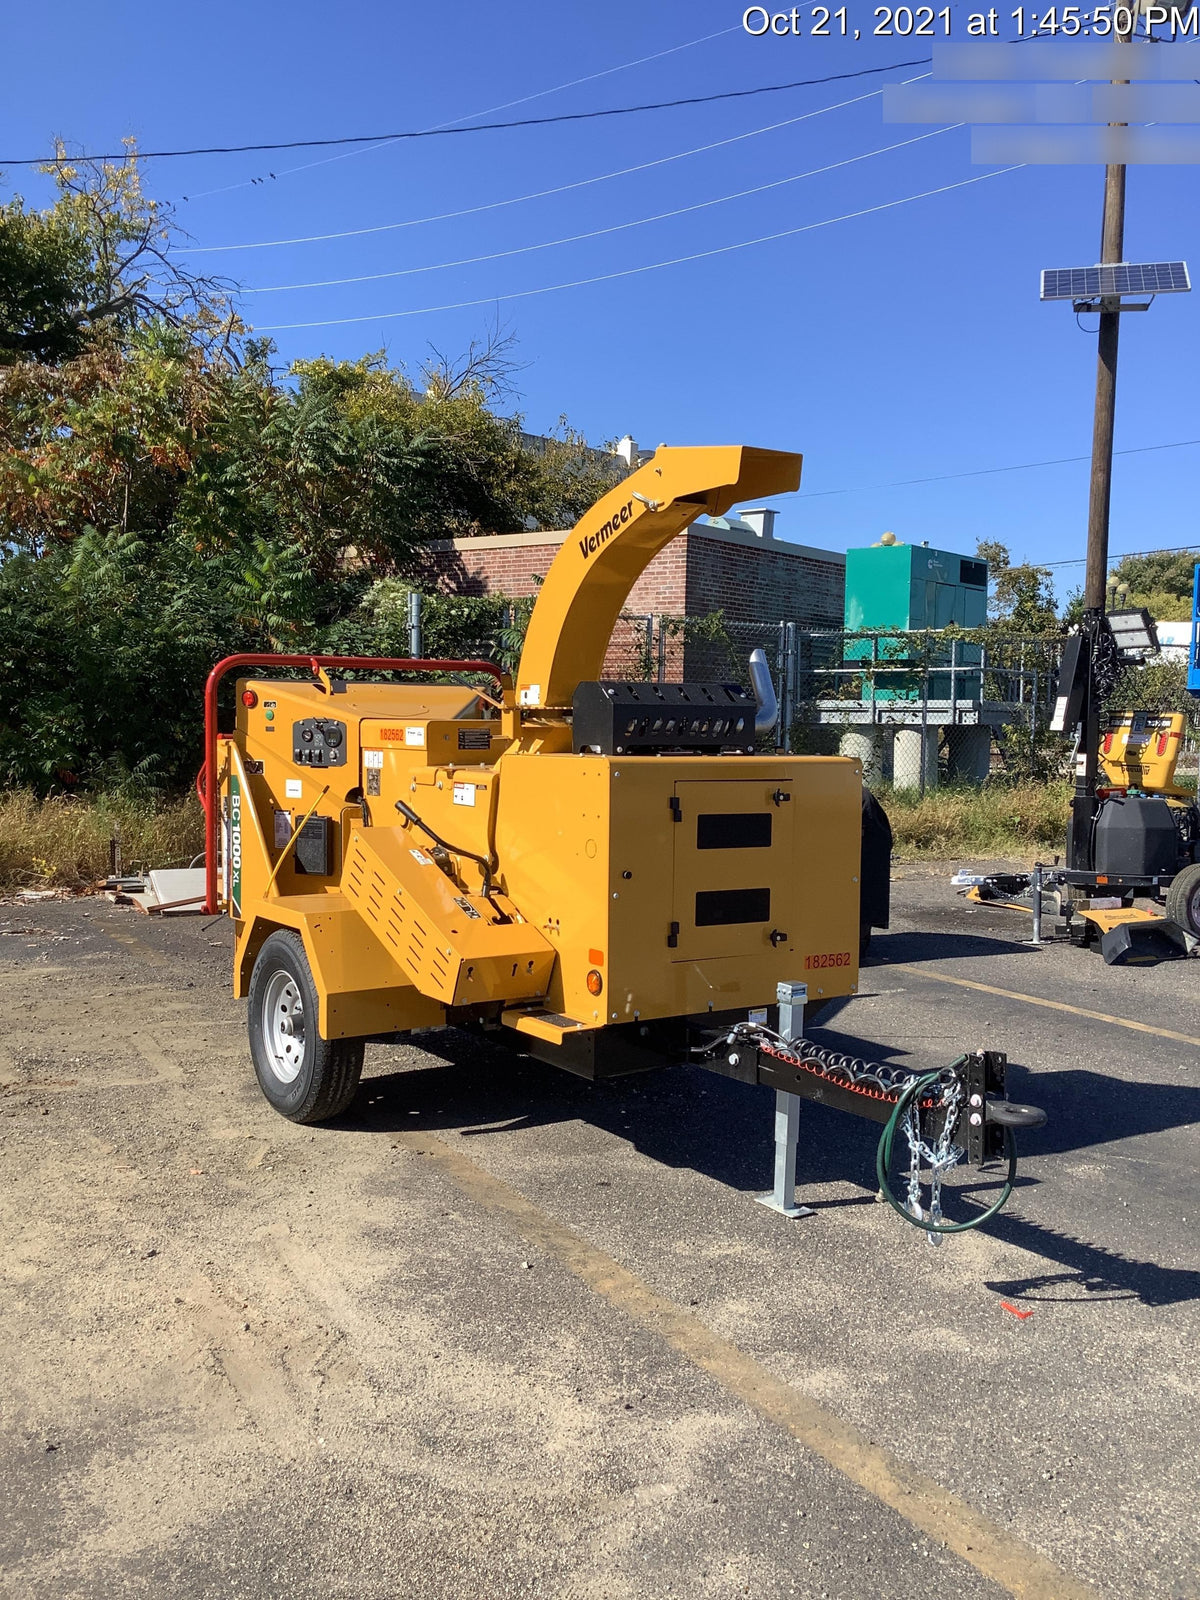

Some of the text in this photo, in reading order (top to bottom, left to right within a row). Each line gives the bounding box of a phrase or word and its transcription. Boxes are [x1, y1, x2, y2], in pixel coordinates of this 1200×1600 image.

[579, 500, 633, 559] Vermeer
[380, 728, 404, 741] 182562
[231, 795, 242, 887] BC1000 XL
[805, 952, 851, 970] 182562
